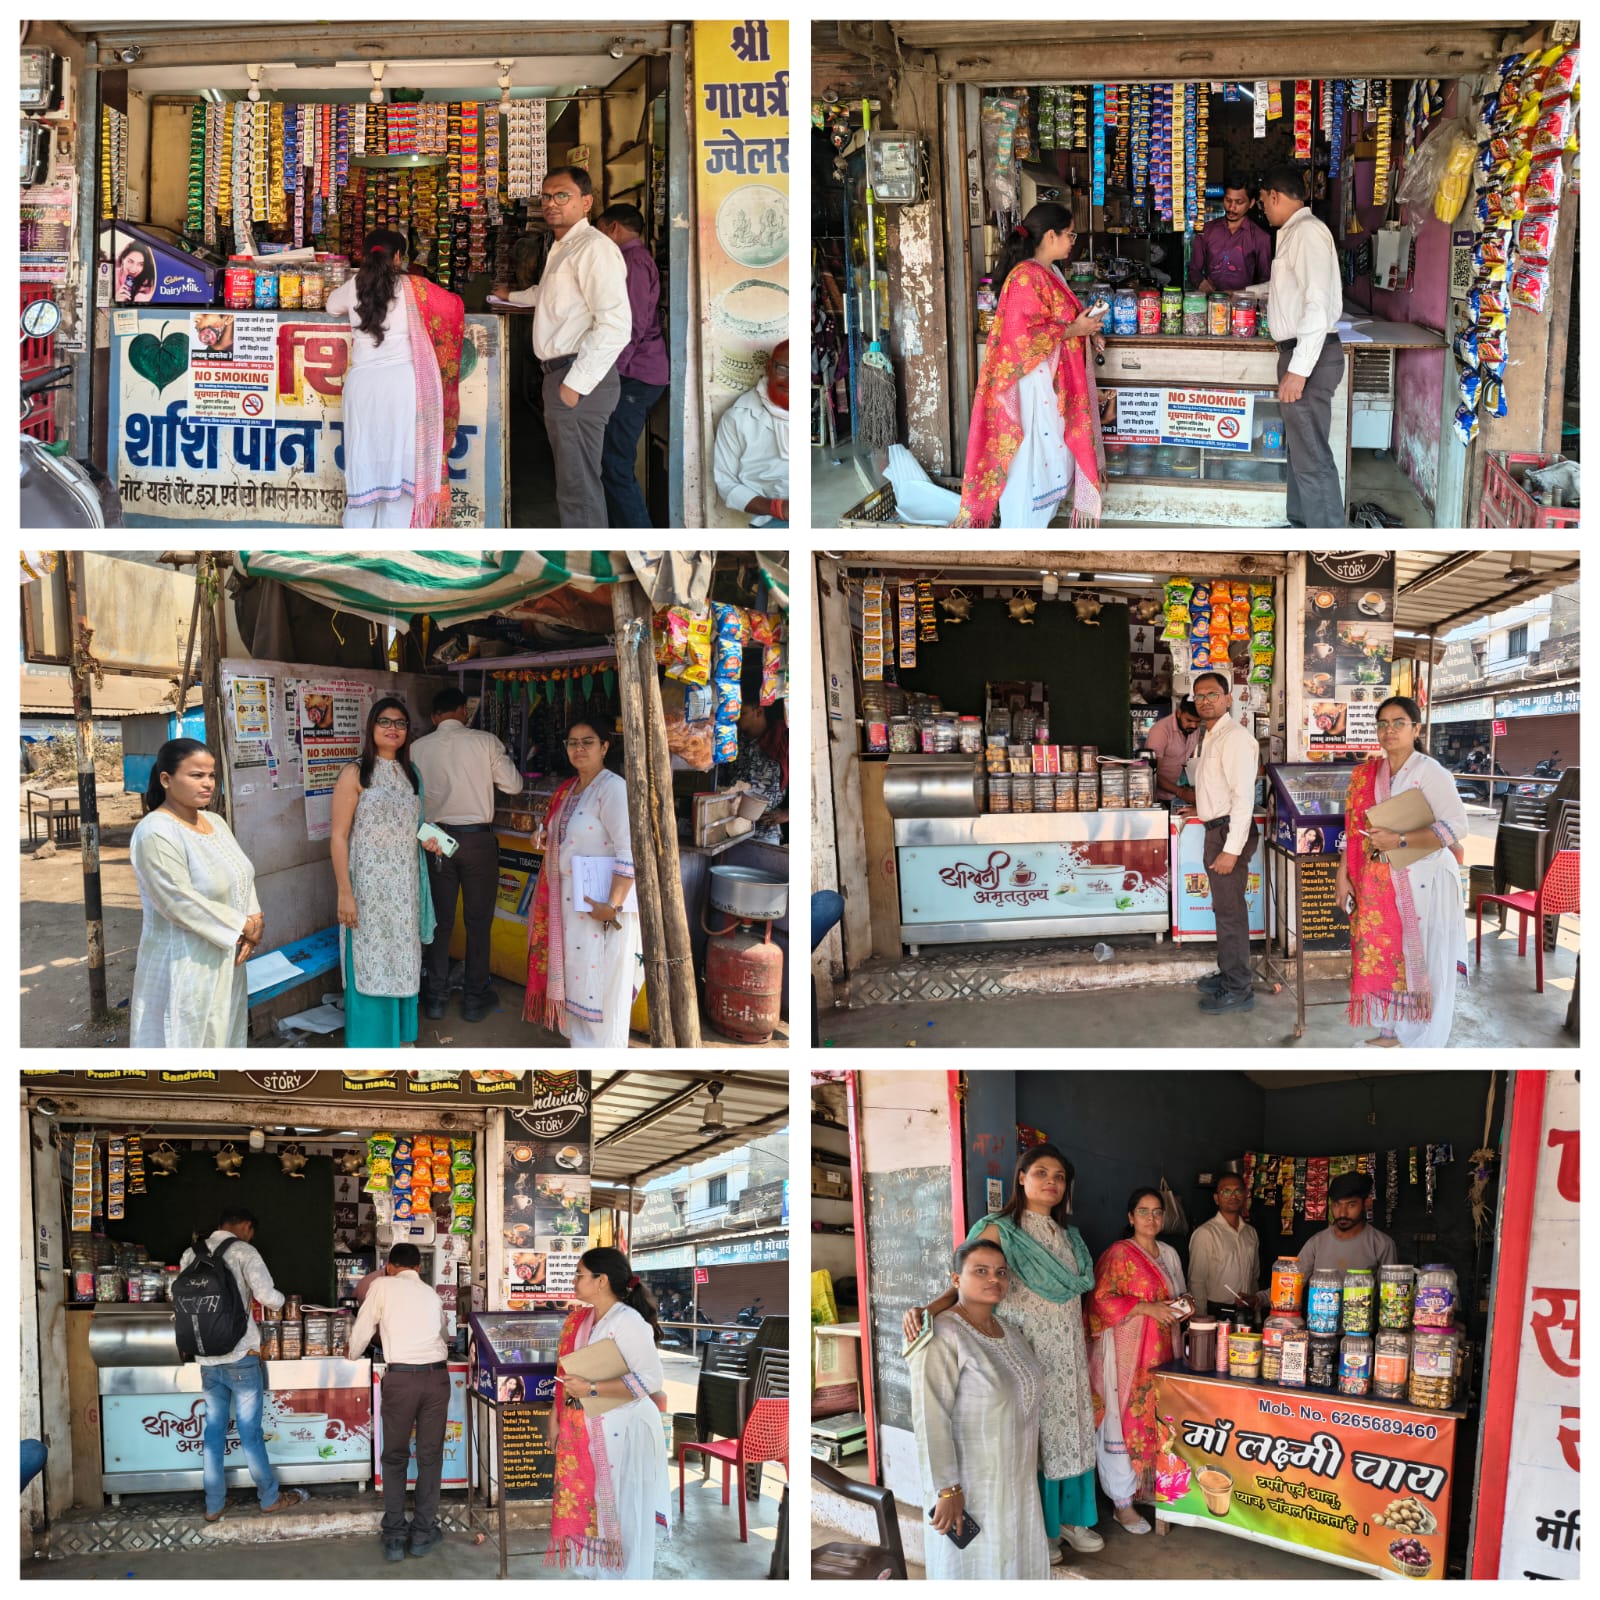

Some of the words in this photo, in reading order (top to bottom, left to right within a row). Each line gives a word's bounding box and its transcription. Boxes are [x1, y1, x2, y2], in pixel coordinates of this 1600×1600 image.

[731, 20, 770, 61] श्री
[160, 286, 181, 295] Dairy
[194, 371, 212, 381] NO
[214, 371, 269, 383] SMOKING
[1168, 391, 1186, 403] NO
[1188, 393, 1246, 407] SMOKING
[1337, 564, 1367, 577] STORY
[307, 749, 319, 758] NO
[321, 747, 358, 757] SMOKING
[162, 1070, 216, 1082] Sandwich
[263, 1074, 301, 1089] STORY
[344, 1080, 363, 1090] Bun
[365, 1079, 396, 1089] maska
[409, 1081, 429, 1092] Milk
[430, 1081, 459, 1091] Shake
[477, 1081, 516, 1093] Mocktail
[518, 1087, 586, 1114] ndwich
[535, 1119, 564, 1132] STORY
[753, 1240, 763, 1251] दी
[1259, 1399, 1295, 1417] Mob.
[1300, 1406, 1326, 1422] No.
[1331, 1411, 1437, 1440] 6265689460
[1236, 1432, 1344, 1477] लक्ष्मी
[1352, 1451, 1448, 1502] चाय
[1256, 1475, 1283, 1493] टपरी
[1287, 1482, 1306, 1498] एवं
[1306, 1505, 1344, 1529] मिलता
[1345, 1513, 1359, 1533] है
